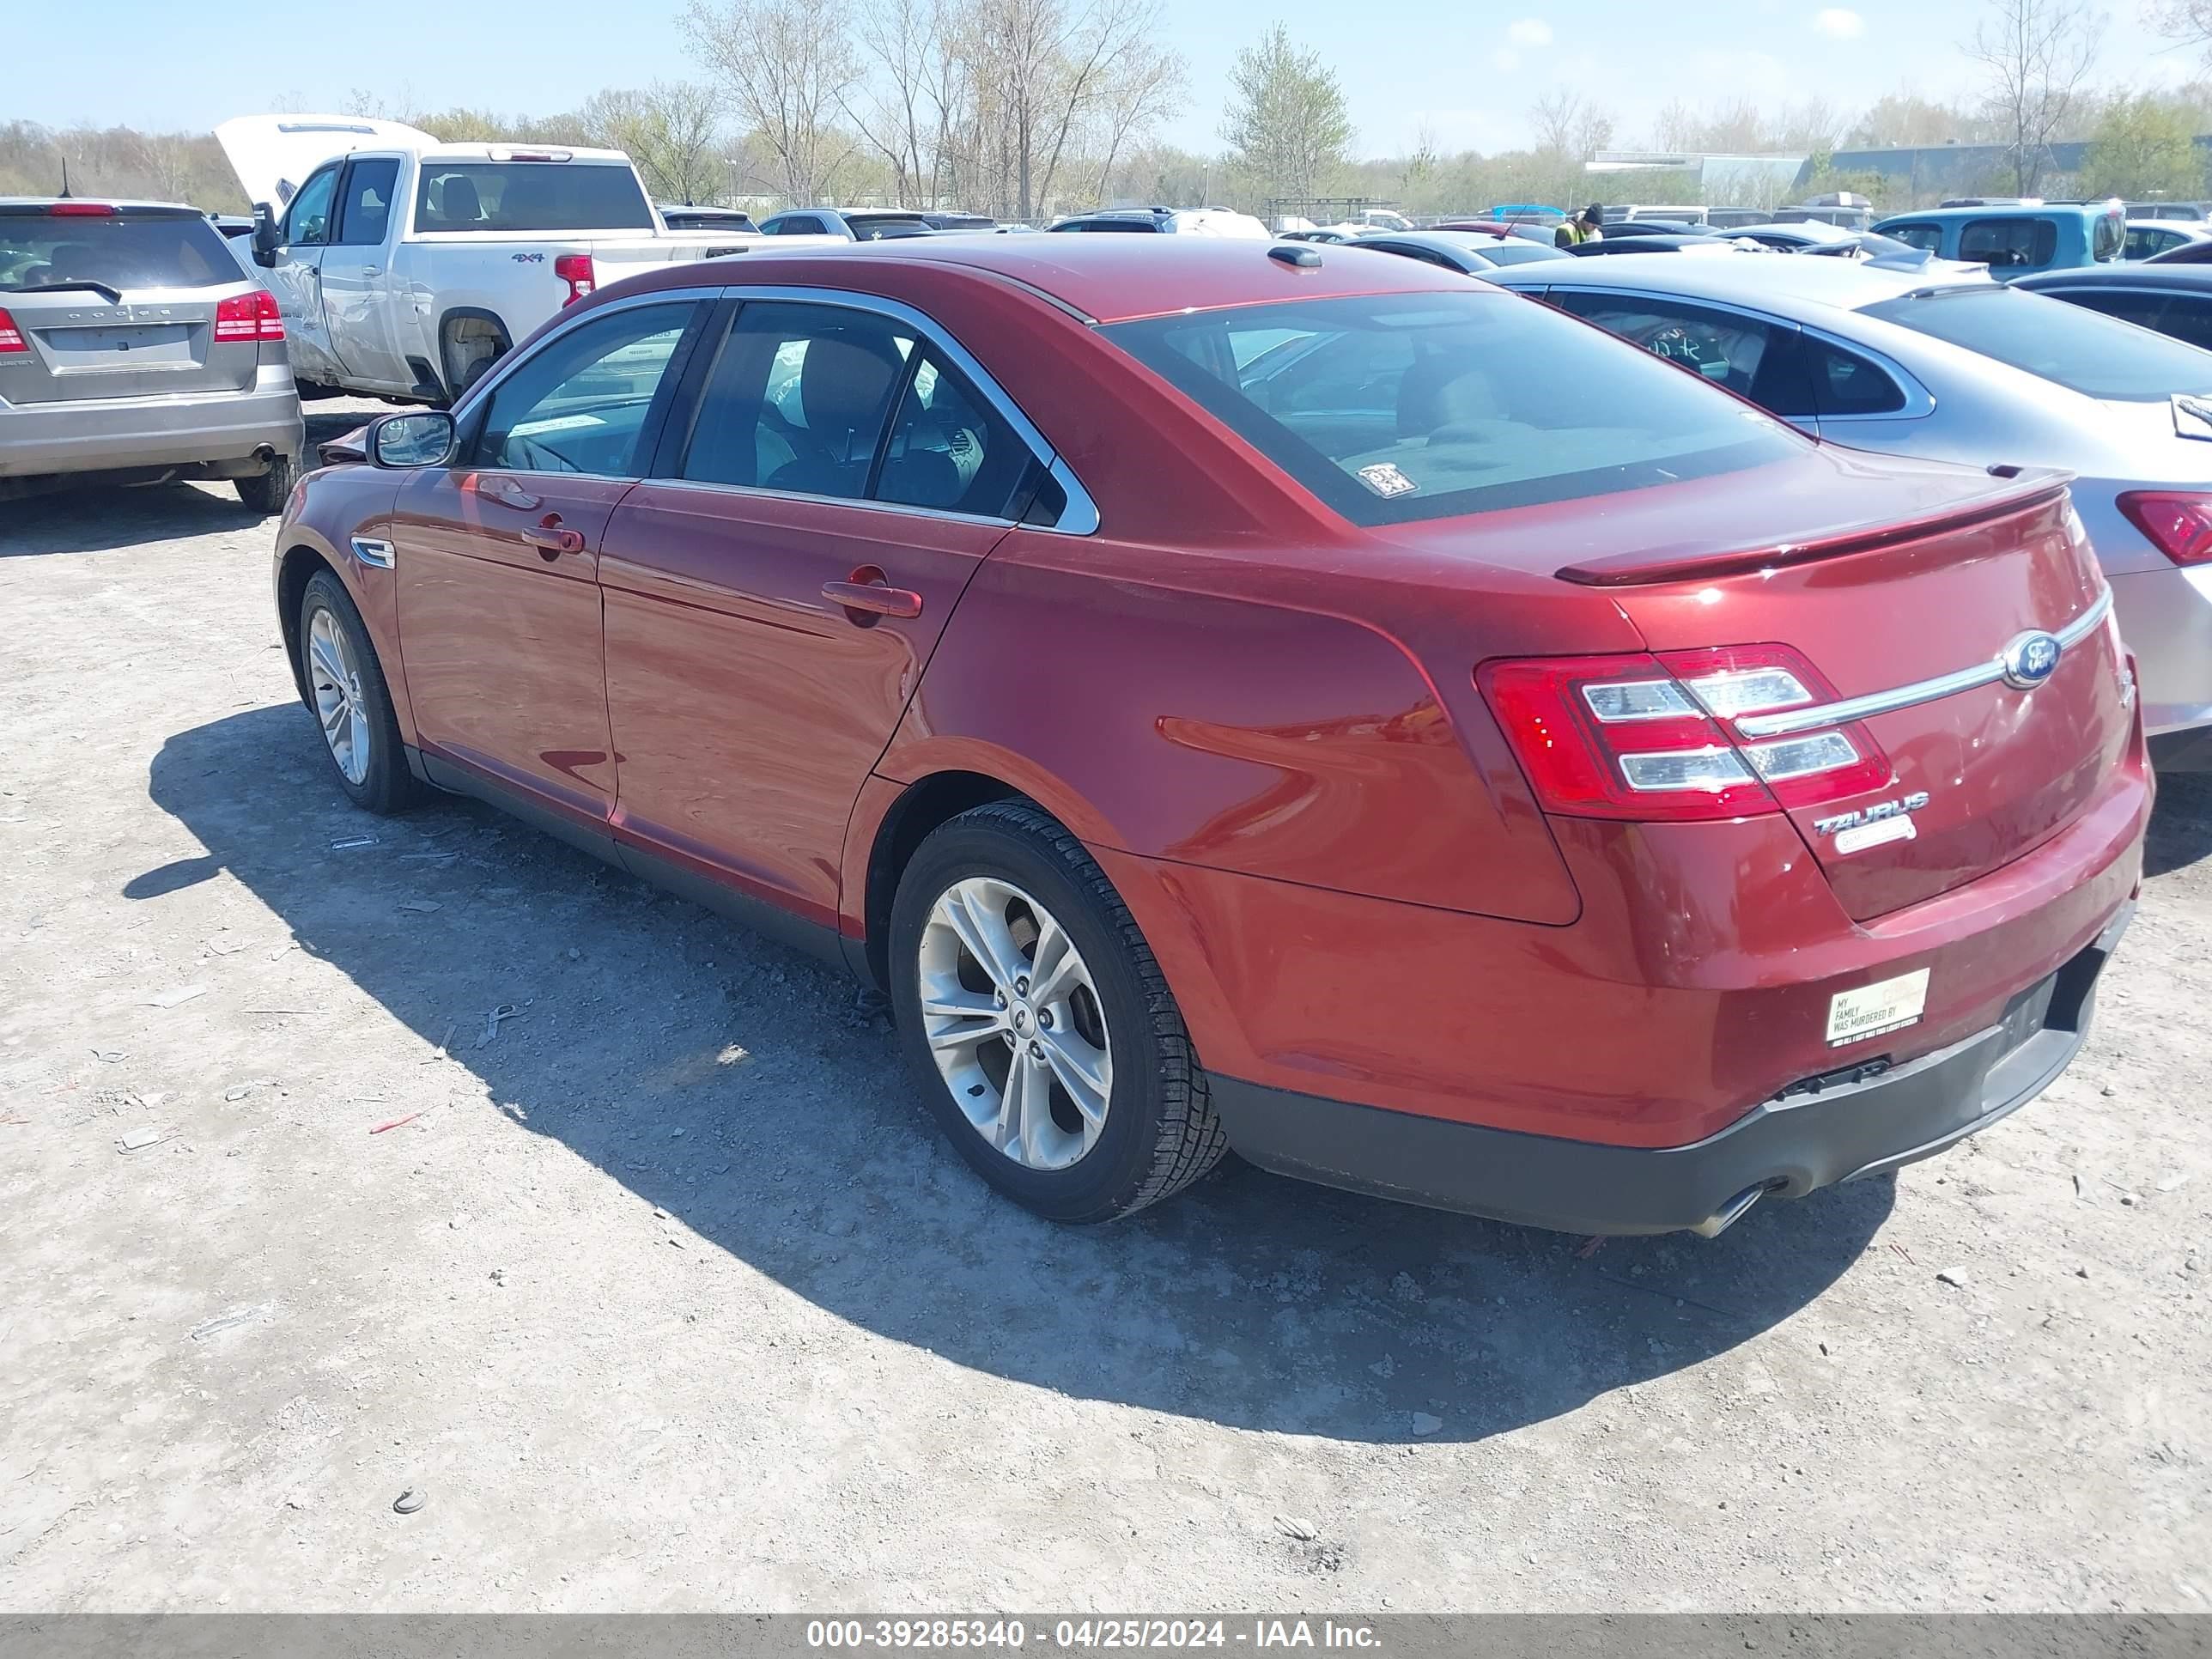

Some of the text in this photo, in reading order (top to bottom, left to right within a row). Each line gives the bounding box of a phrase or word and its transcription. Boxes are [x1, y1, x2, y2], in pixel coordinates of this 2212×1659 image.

[1813, 791, 1929, 836] TAURUS
[1835, 1006, 1861, 1021] FAMILY
[1837, 998, 1849, 1011] MY
[1833, 1006, 1897, 1033] WAS MURDERED BY
